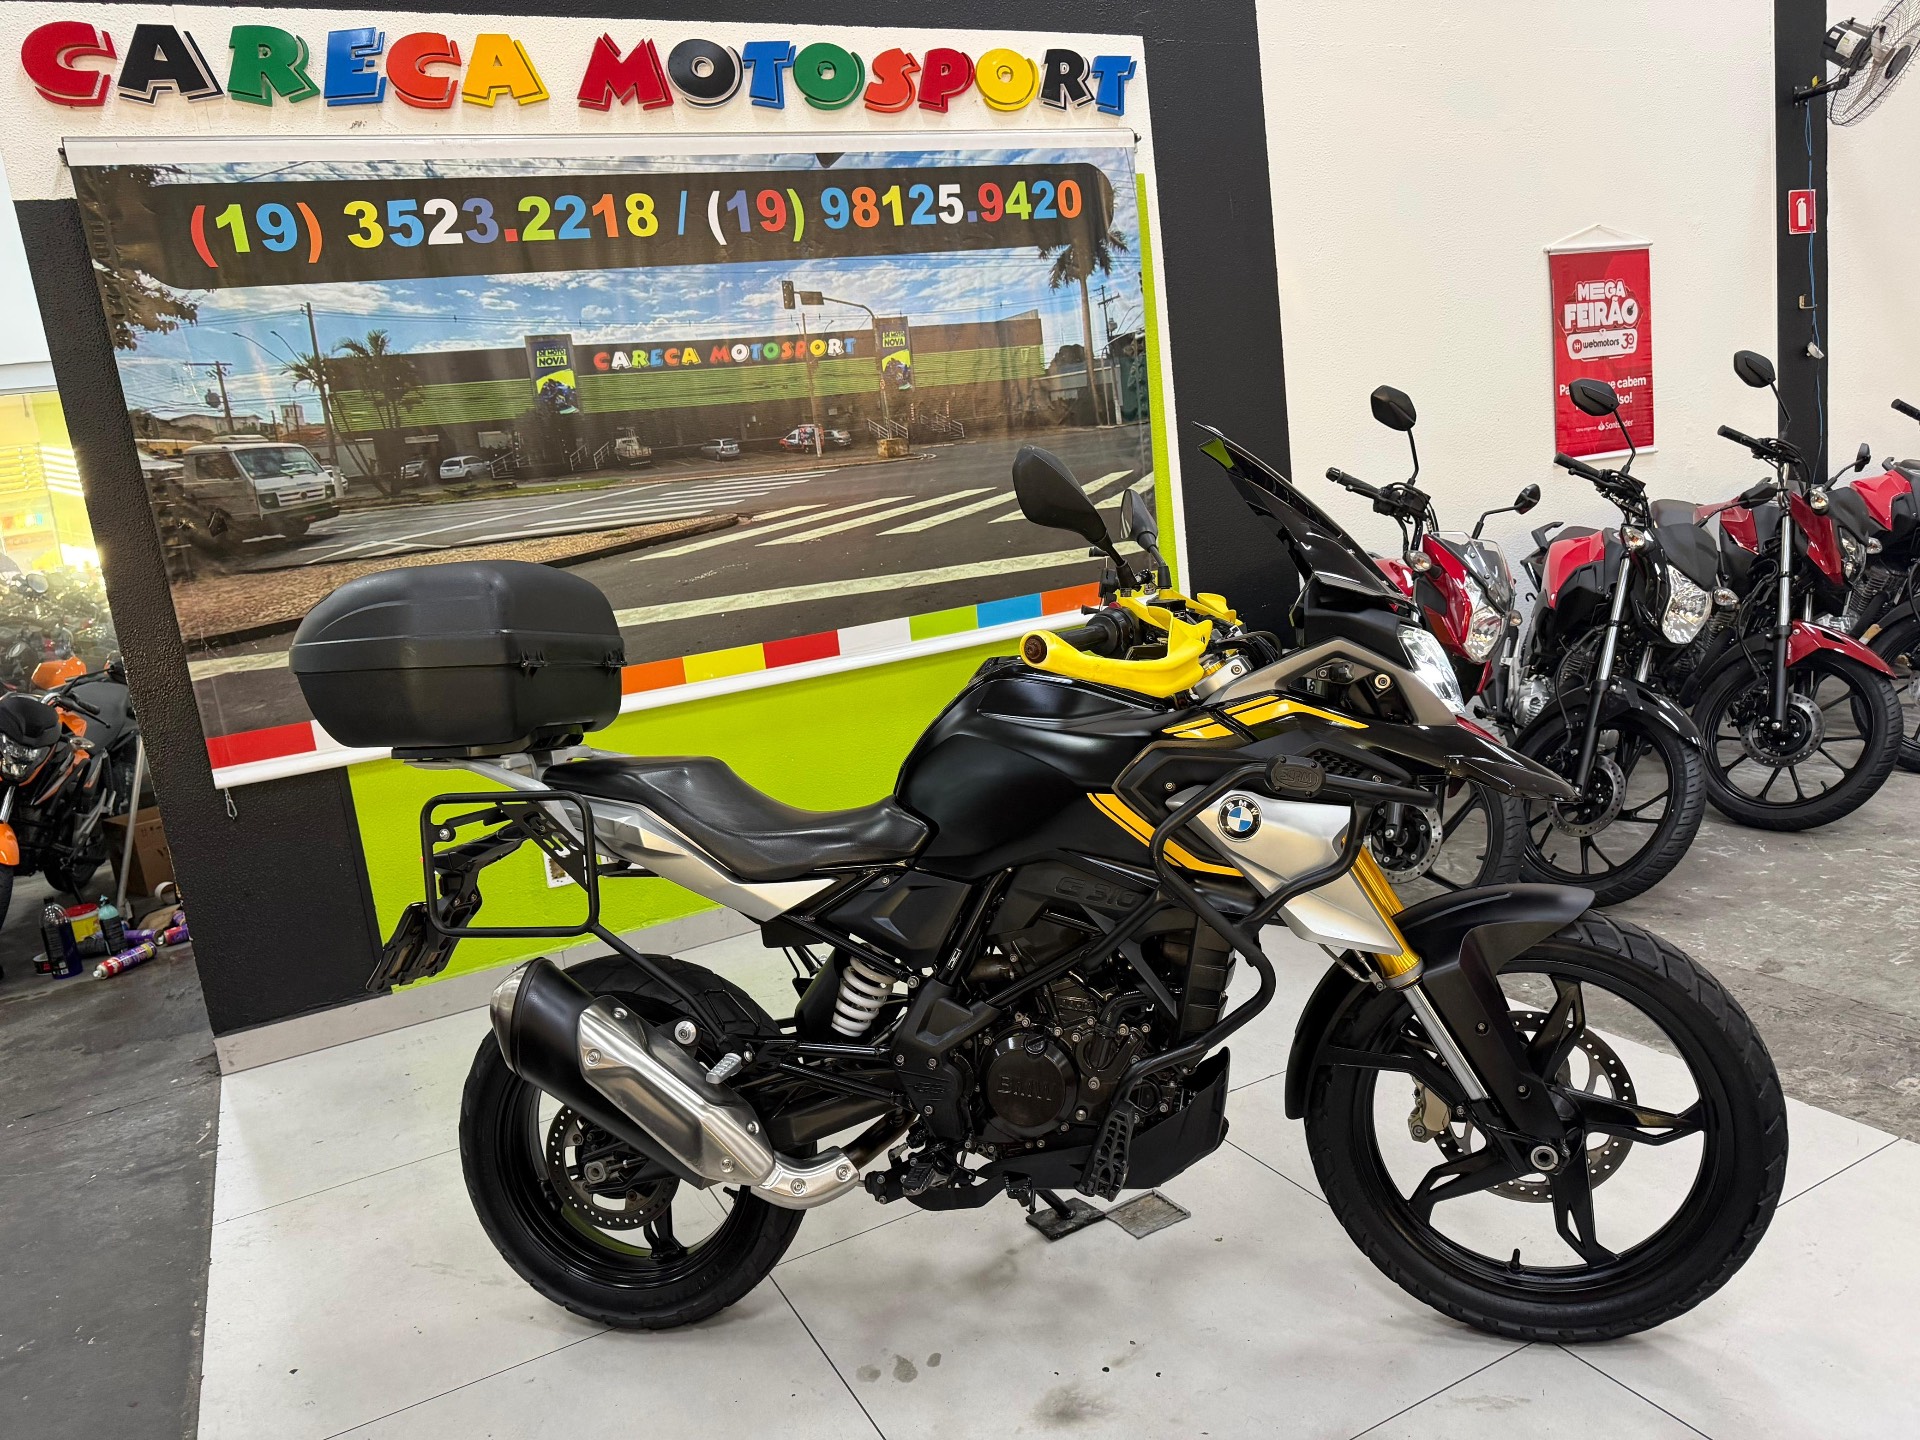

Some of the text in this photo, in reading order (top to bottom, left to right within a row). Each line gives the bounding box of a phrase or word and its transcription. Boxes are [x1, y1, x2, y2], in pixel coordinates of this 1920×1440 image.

[20, 21, 1137, 116] CARECA MOTOSPORT
[191, 201, 323, 268] (19)
[344, 193, 659, 249] 3523.2218
[707, 188, 804, 246] (19)
[822, 179, 1083, 230] 98125.9420
[1577, 281, 1626, 302] MEGA
[1564, 296, 1639, 330] FEIRÃO
[884, 338, 904, 347] NOVA
[1583, 338, 1620, 349] webmotors
[538, 357, 566, 366] NOVA
[593, 338, 857, 371] CARECA MOTOSPORT
[1617, 376, 1647, 389] cabem
[1616, 391, 1633, 405] lso!
[1226, 799, 1260, 816] BMW
